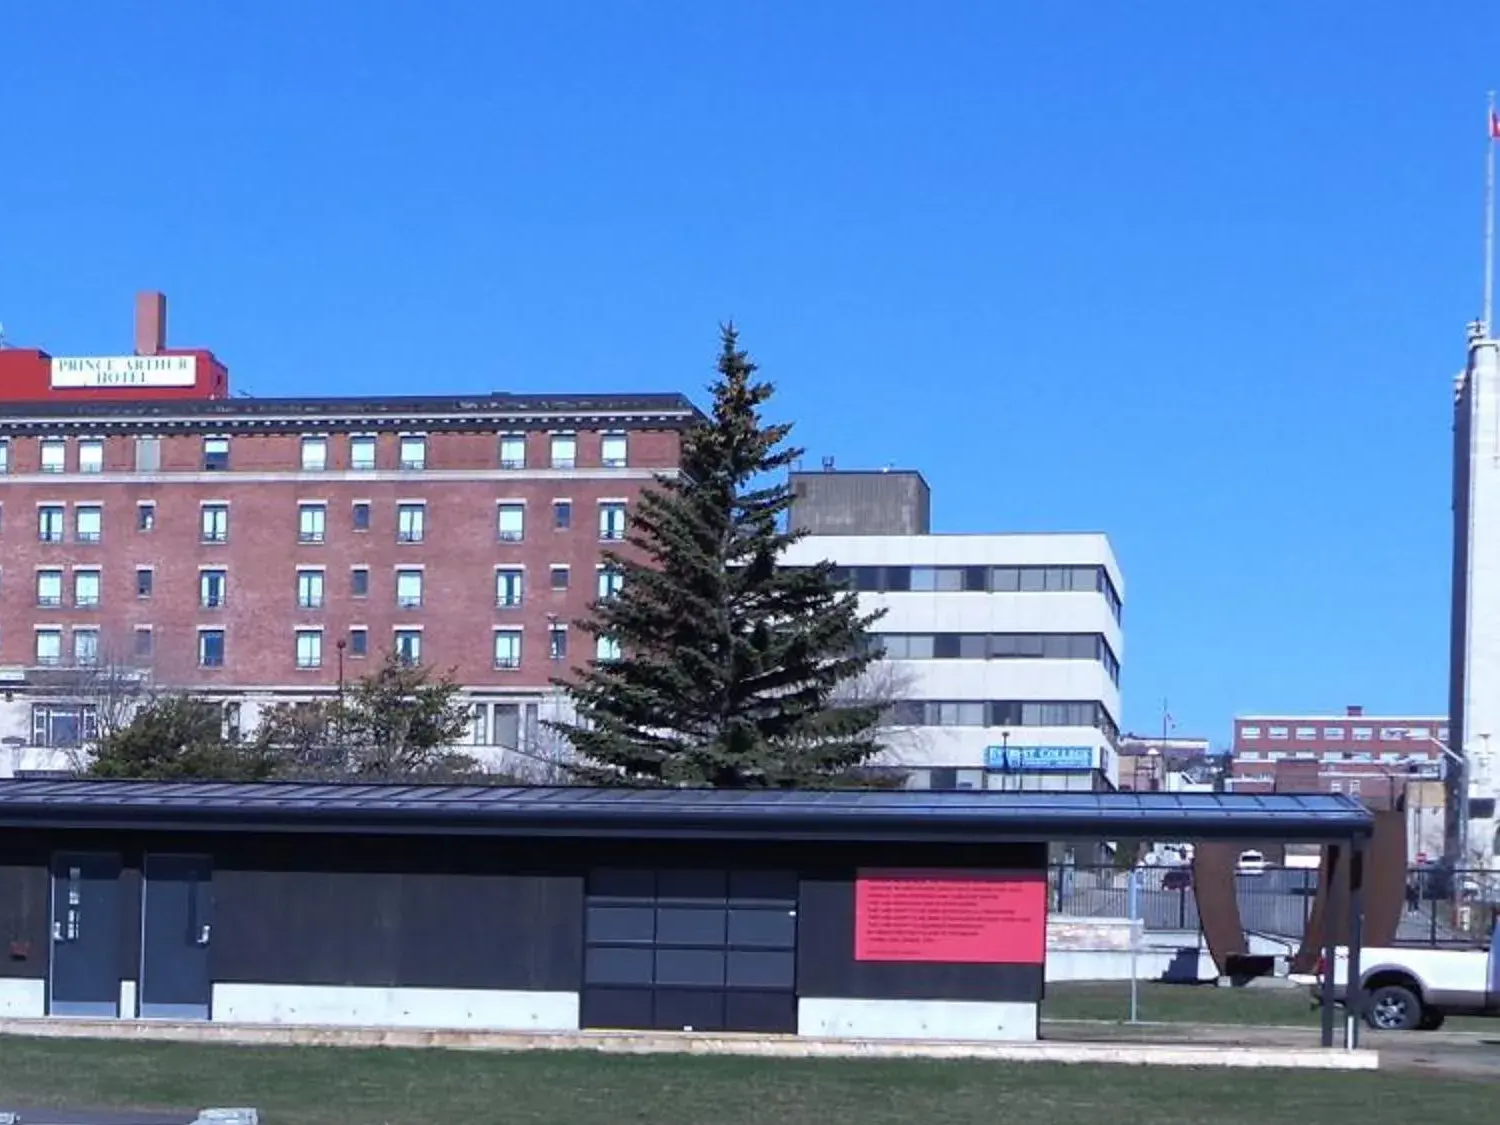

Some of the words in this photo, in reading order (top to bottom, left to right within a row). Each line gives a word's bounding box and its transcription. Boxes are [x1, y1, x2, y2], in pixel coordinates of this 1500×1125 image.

[59, 359, 113, 372] PRINCE
[126, 359, 187, 370] ARTHUR
[96, 371, 146, 383] HOTEL
